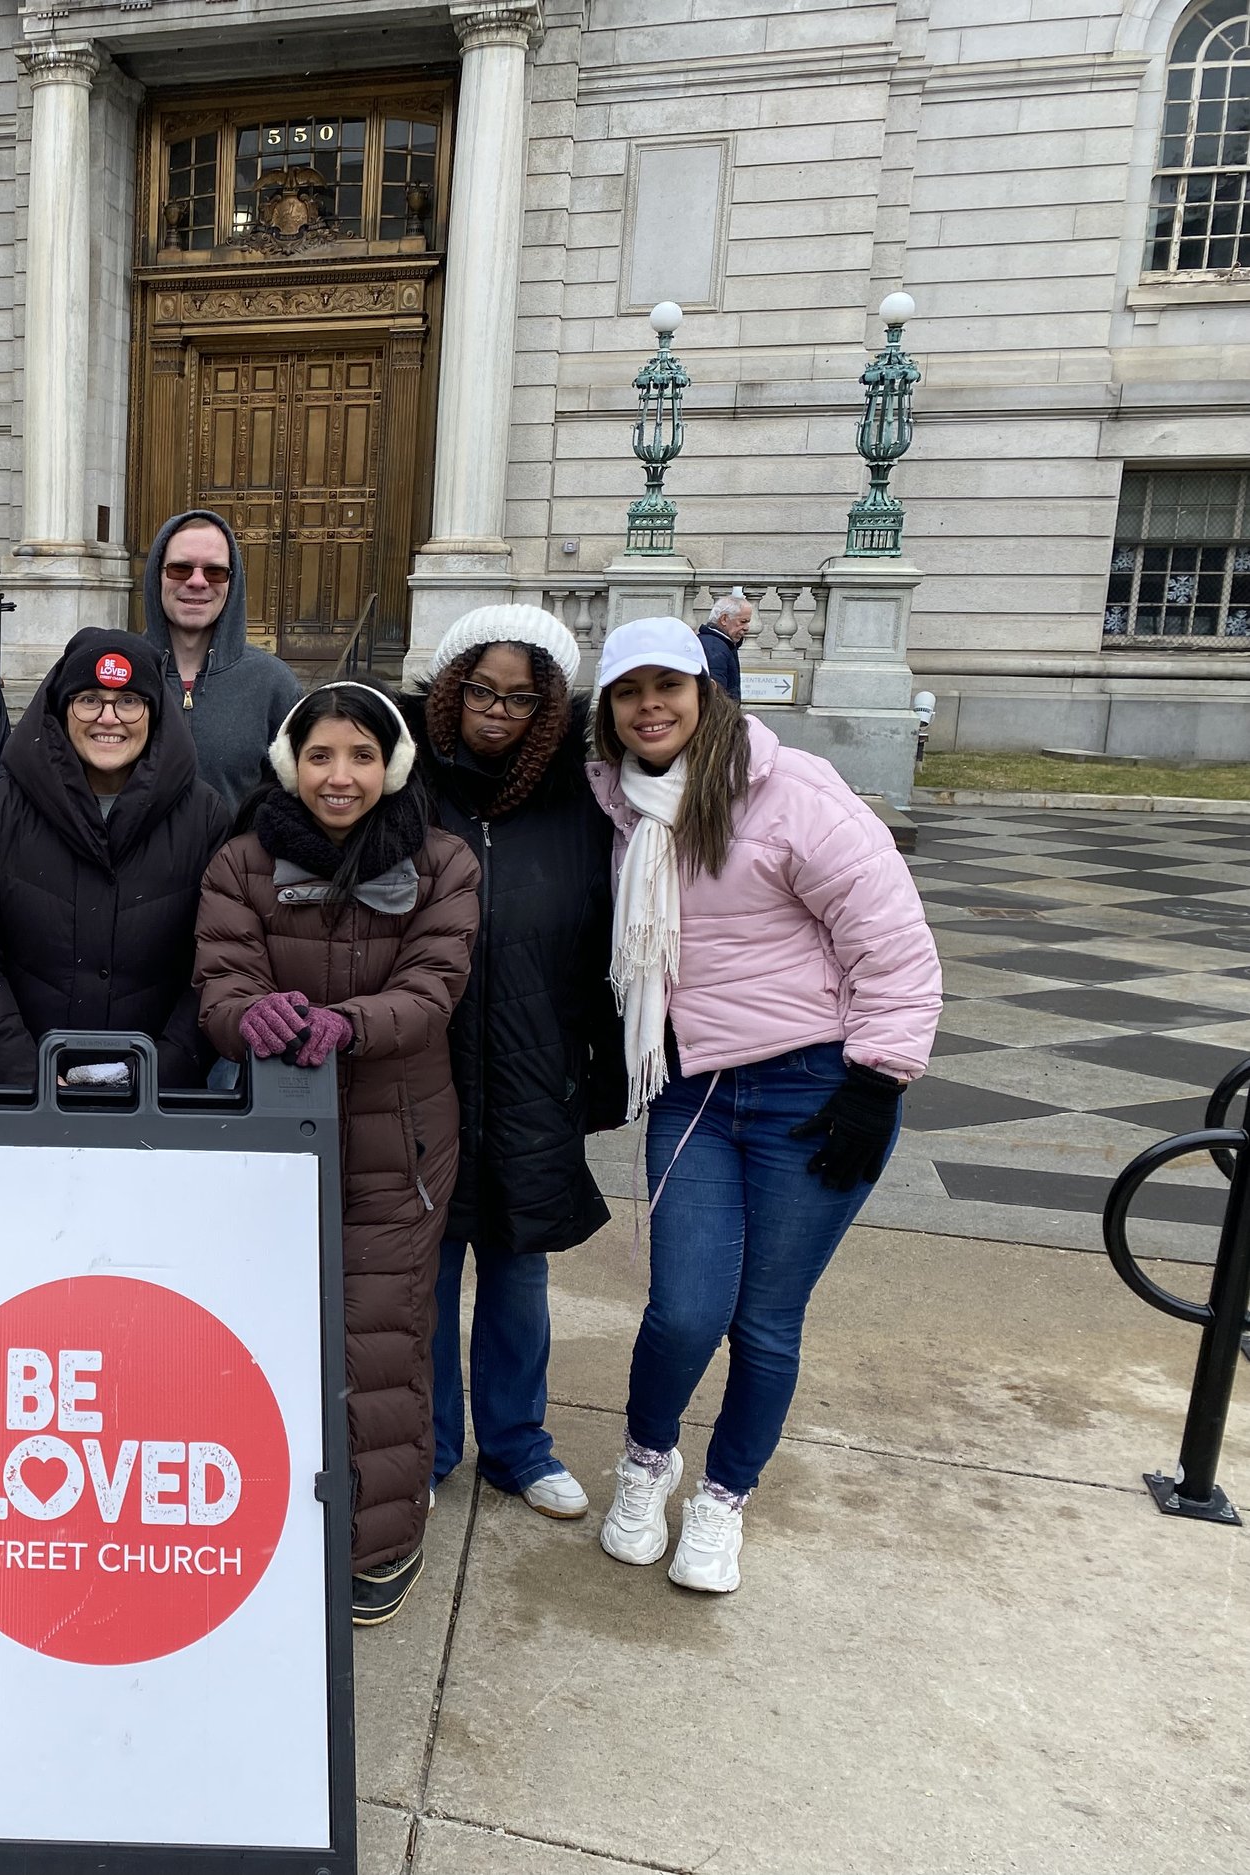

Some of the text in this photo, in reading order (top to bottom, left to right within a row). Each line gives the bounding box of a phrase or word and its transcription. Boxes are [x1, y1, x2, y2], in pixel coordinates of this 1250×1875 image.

[267, 125, 334, 145] 550
[100, 666, 127, 677] LOVED
[105, 659, 115, 667] BE
[6, 1348, 103, 1432] BE
[98, 1543, 242, 1576] CHURCH
